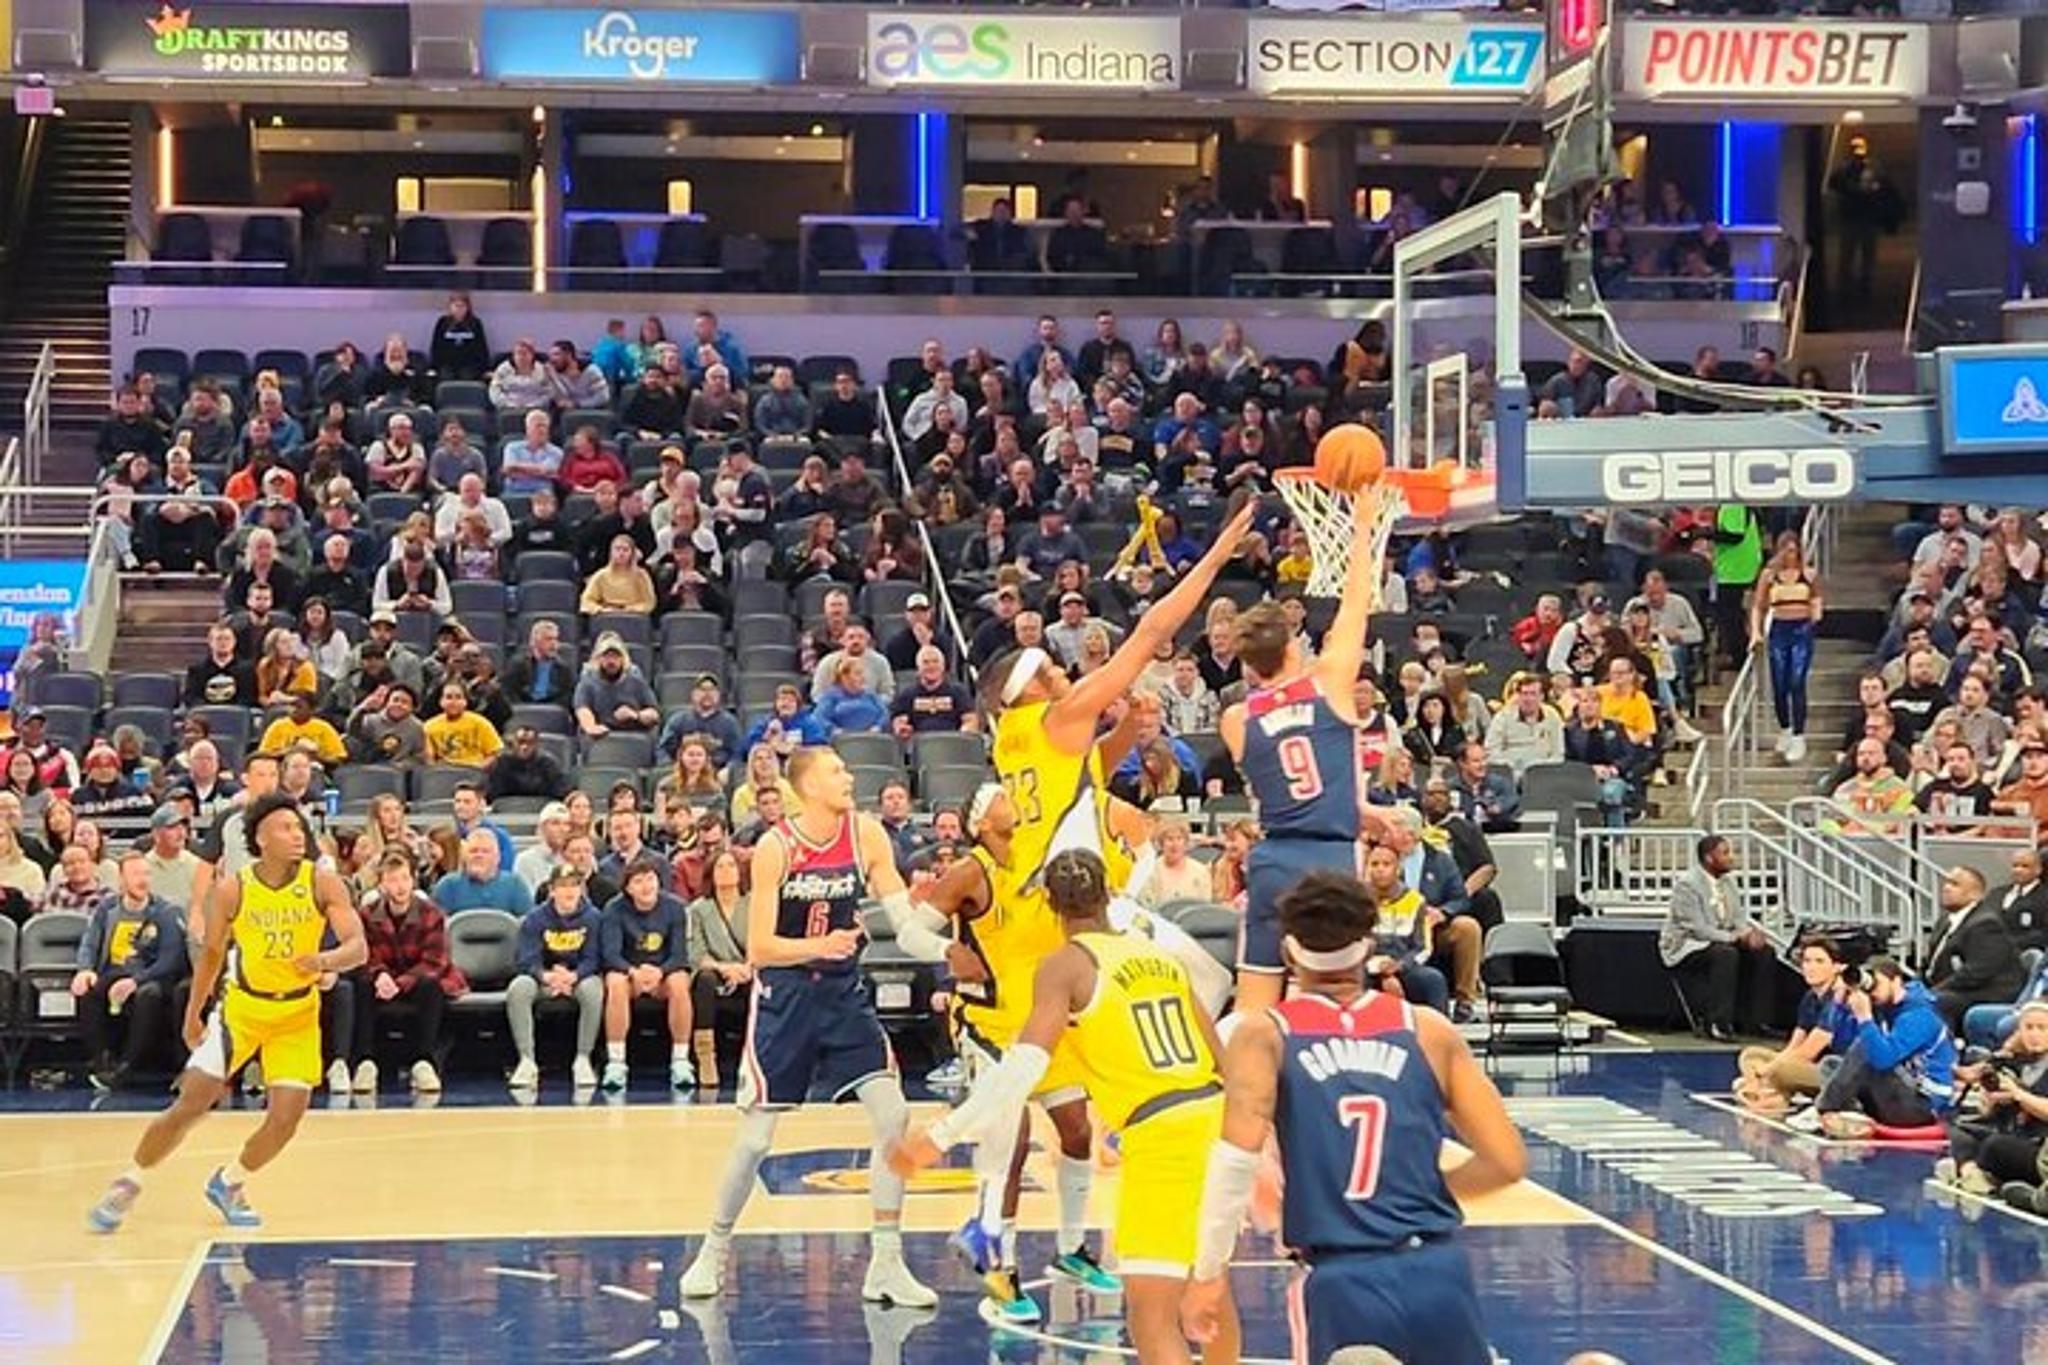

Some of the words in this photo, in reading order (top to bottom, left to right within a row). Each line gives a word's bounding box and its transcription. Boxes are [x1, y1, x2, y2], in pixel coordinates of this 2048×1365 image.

[155, 29, 349, 55] DRAFTKINGS
[202, 53, 348, 73] SPORTSBOOK
[584, 11, 699, 79] Kroger
[874, 22, 1013, 79] aes
[1026, 42, 1175, 82] Indiana
[1258, 39, 1452, 73] SECTION
[1464, 41, 1528, 77] 127
[1645, 30, 1908, 86] POINTSBET
[132, 306, 151, 337] 17
[1603, 449, 1855, 501] GEICO
[1278, 735, 1324, 801] 9
[244, 906, 314, 929] INDIANA
[805, 900, 831, 937] 6
[263, 929, 295, 960] 23
[1131, 997, 1198, 1070] 00
[1337, 1094, 1387, 1201] 7
